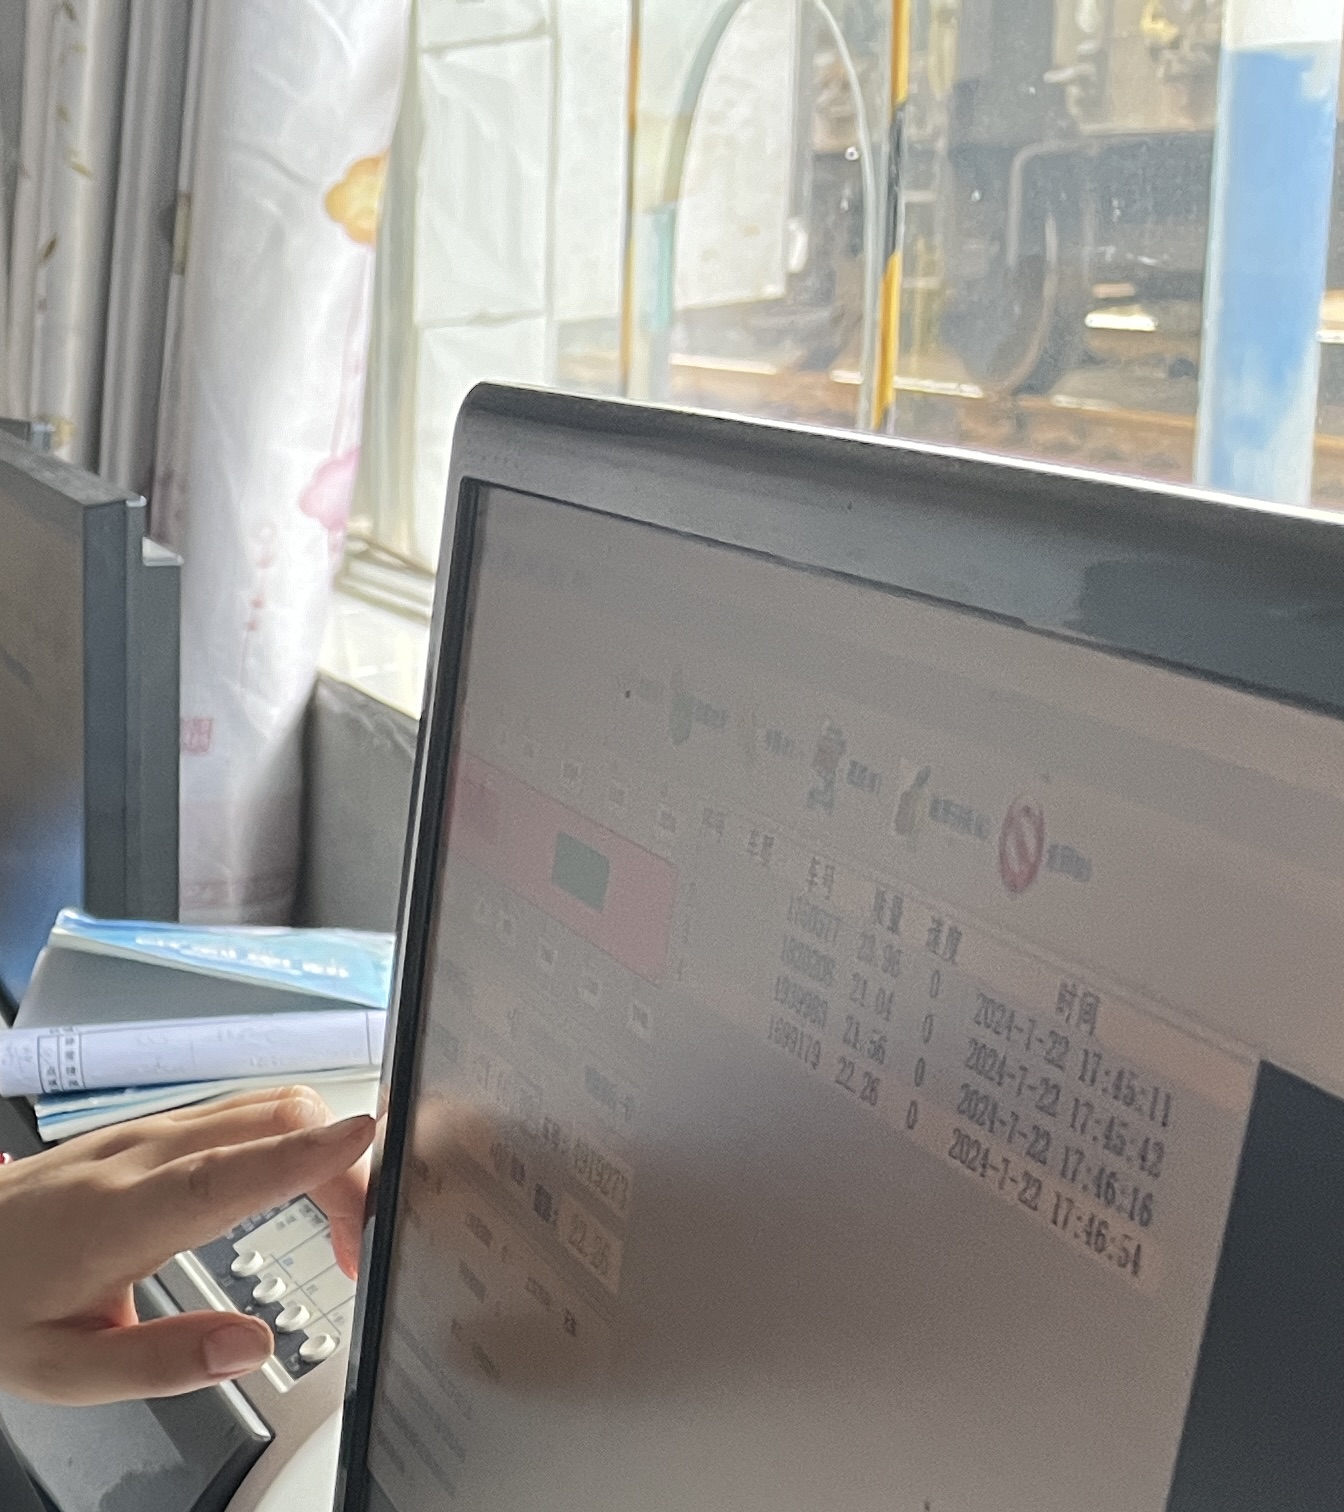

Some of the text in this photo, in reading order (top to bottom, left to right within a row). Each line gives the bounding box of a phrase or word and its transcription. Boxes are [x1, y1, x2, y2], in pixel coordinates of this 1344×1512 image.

[929, 968, 941, 998] 0
[974, 991, 1070, 1071] 2024-7-22
[1081, 1050, 1172, 1128] 17:45:11
[1056, 980, 1101, 1036] 时间
[835, 1056, 879, 1107] 22.26
[905, 1099, 918, 1130] 0
[948, 1126, 1040, 1212] 2024-7-22
[1050, 1191, 1144, 1278] 17:46:54
[914, 1056, 926, 1088] 0
[957, 1081, 1053, 1165] 2024-7-22
[1061, 1144, 1154, 1229] 17:46:16
[922, 1013, 933, 1043] 0
[964, 1037, 1062, 1118] 2024-7-22
[1071, 1097, 1166, 1179] 17:45:42
